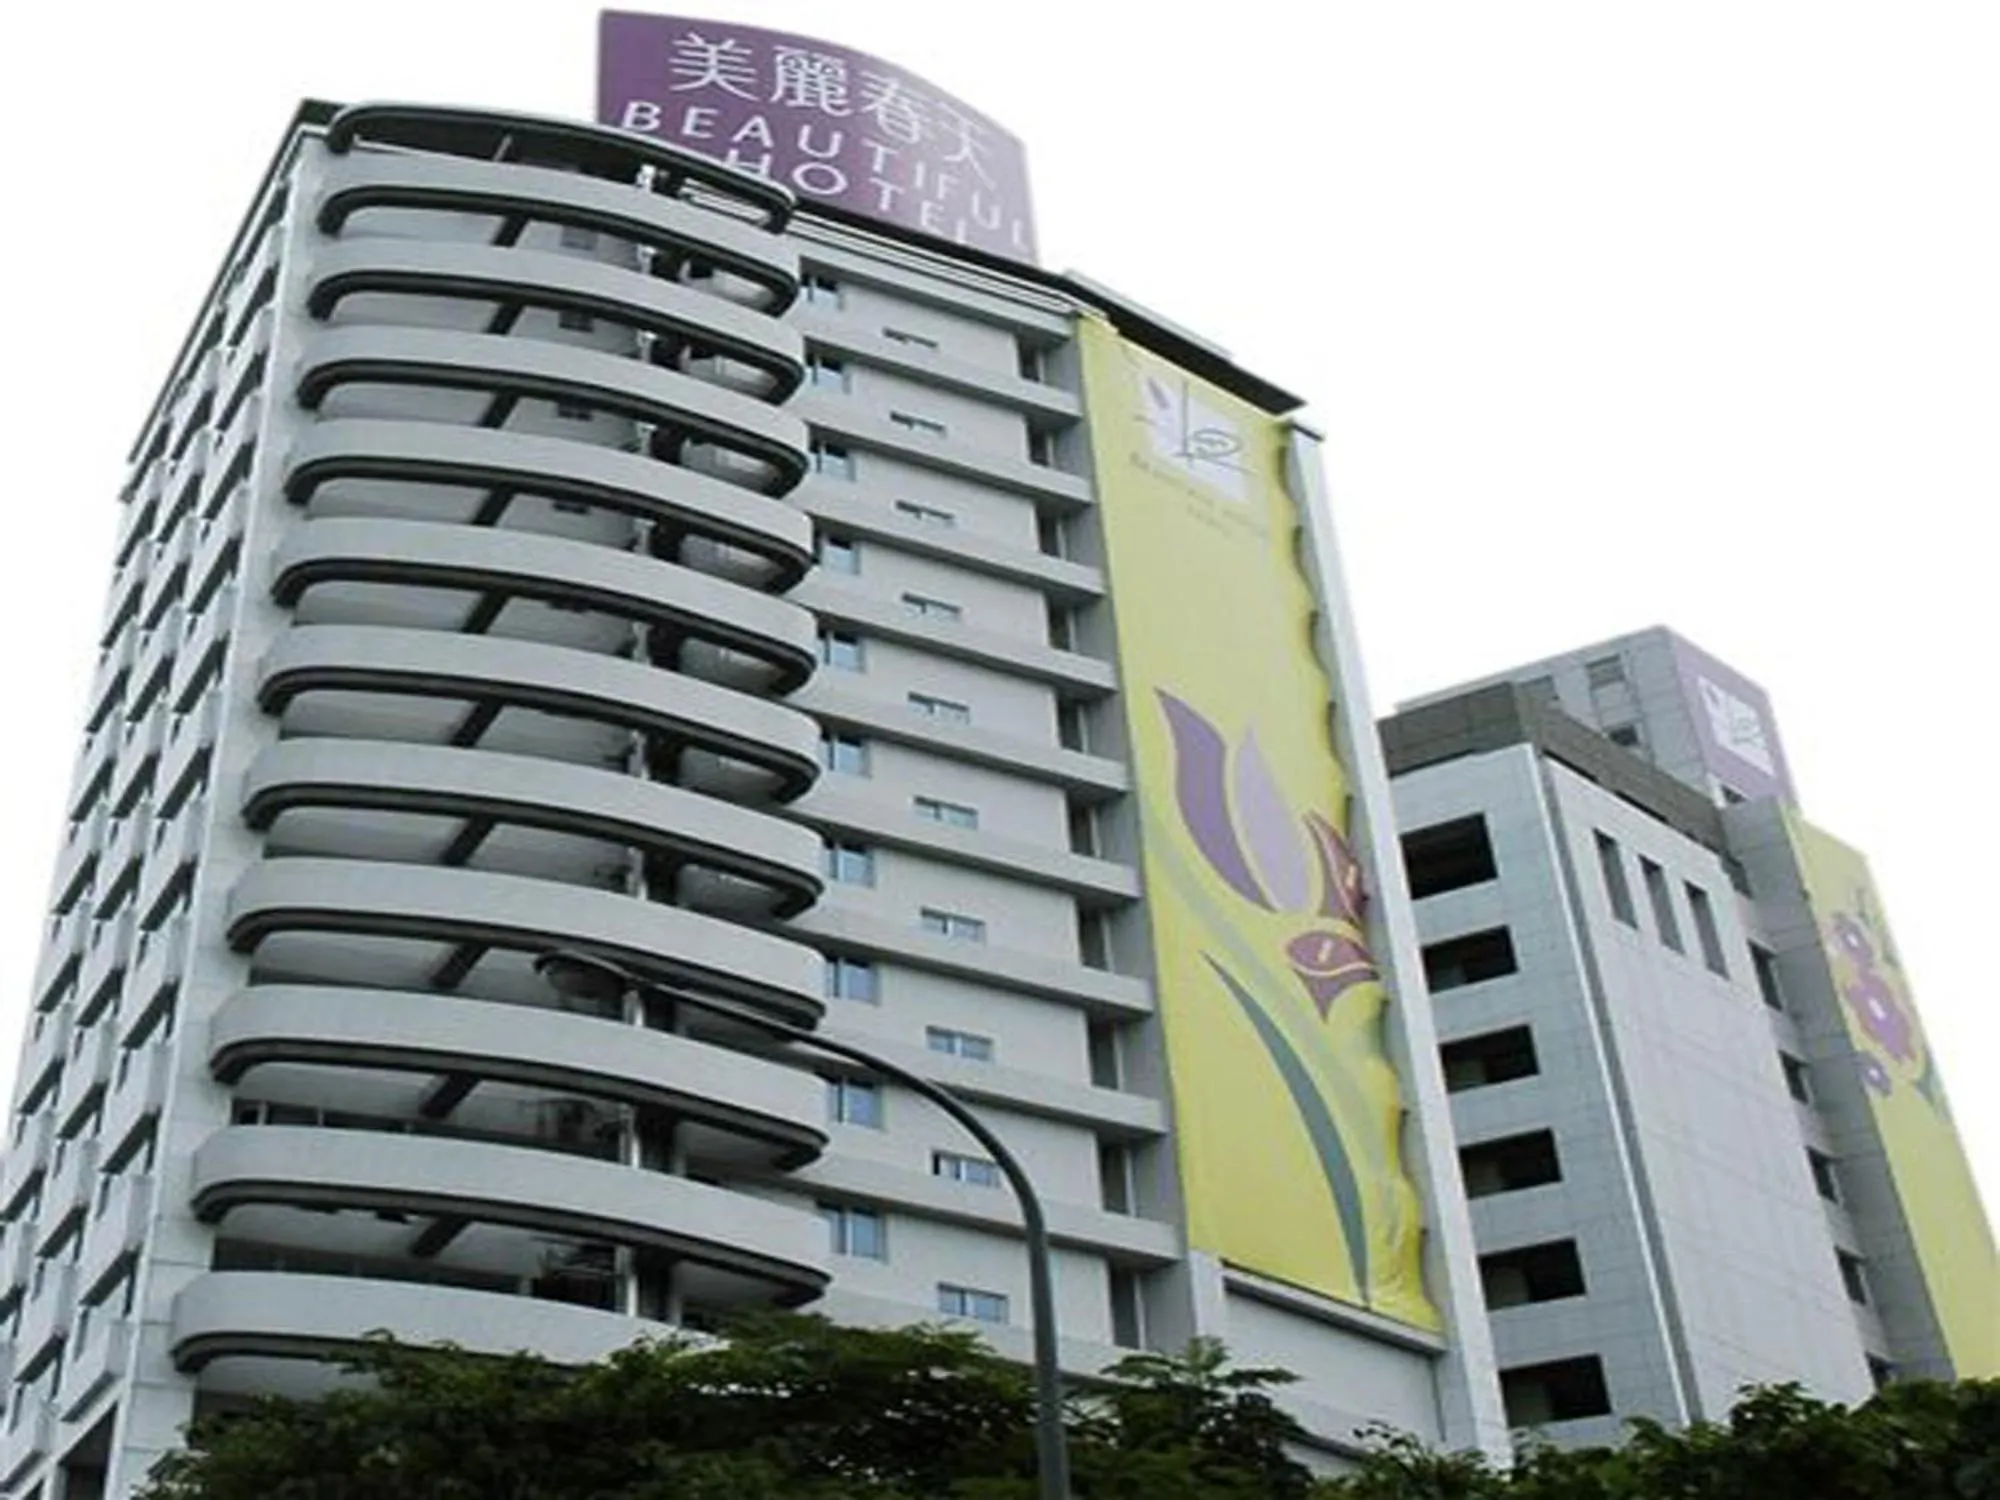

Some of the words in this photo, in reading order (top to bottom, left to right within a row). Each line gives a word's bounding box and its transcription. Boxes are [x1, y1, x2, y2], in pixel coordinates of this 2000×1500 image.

[620, 101, 1029, 252] BEAUTIFUL
[668, 31, 1000, 193] 美麗春天
